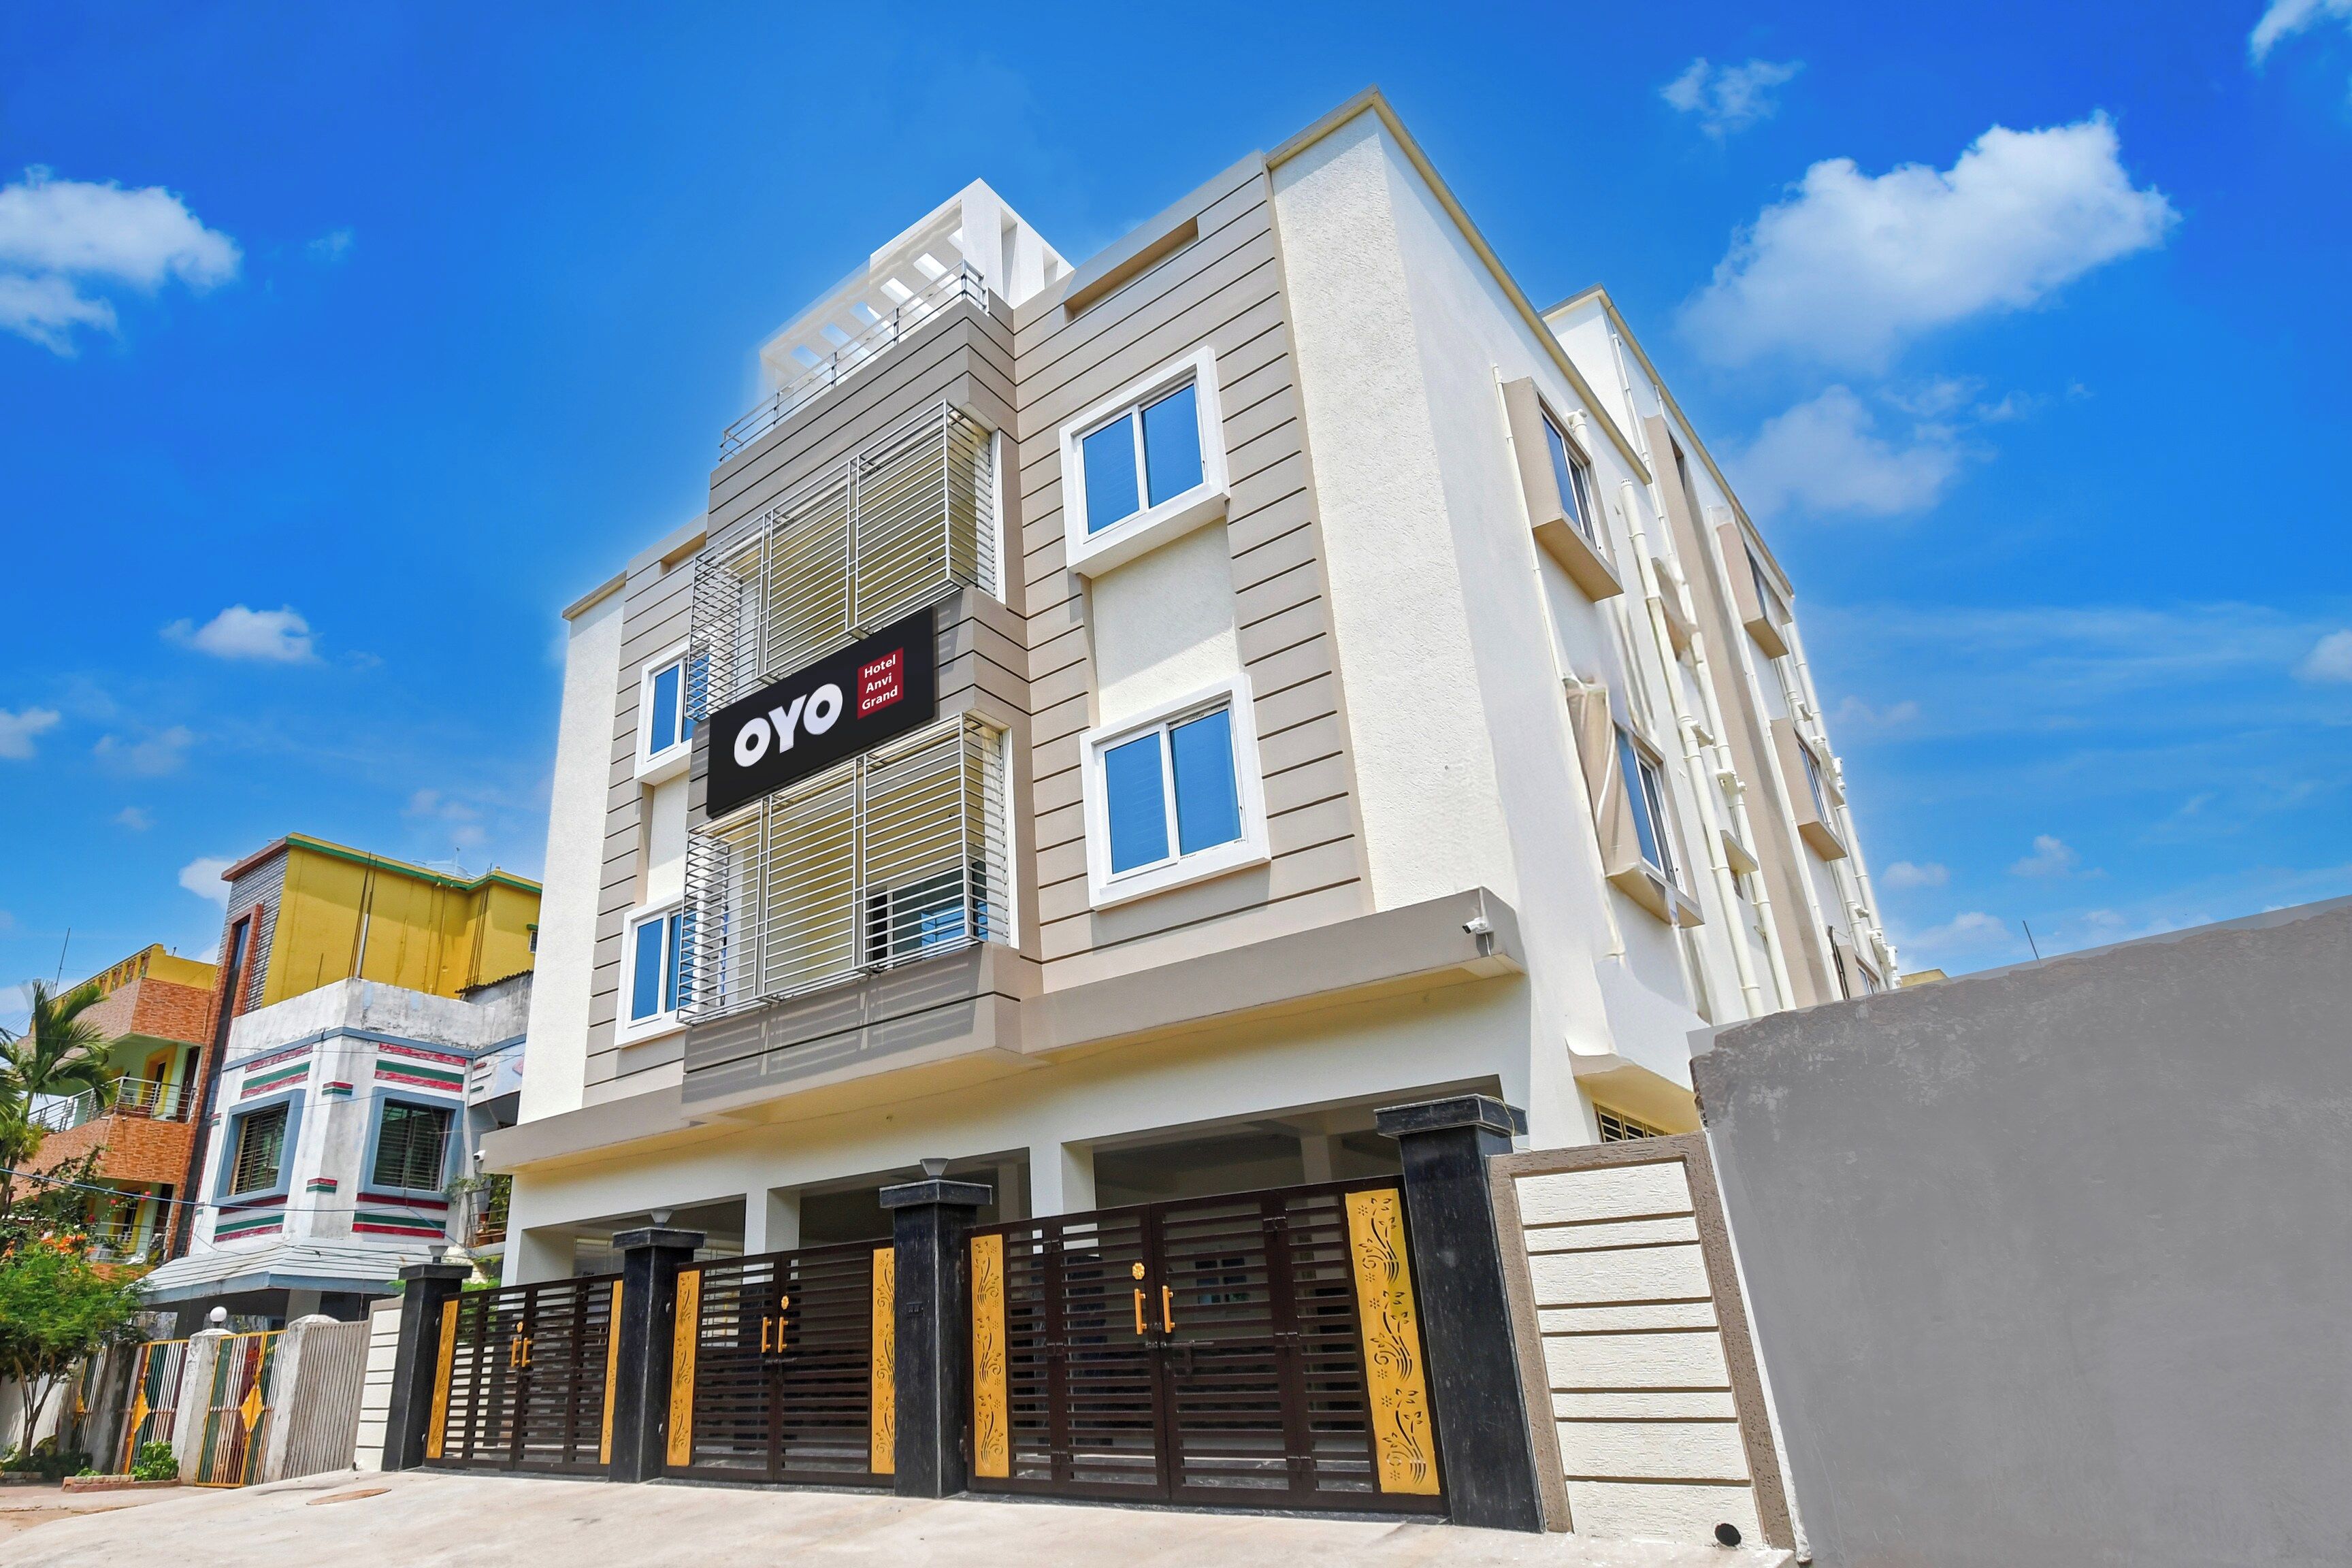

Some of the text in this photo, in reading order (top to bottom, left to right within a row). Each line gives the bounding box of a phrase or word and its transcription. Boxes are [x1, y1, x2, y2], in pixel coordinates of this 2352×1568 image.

[864, 654, 896, 679] Hotel
[866, 672, 892, 694] Anvi
[862, 685, 898, 710] Grand
[734, 683, 843, 768] OYO
